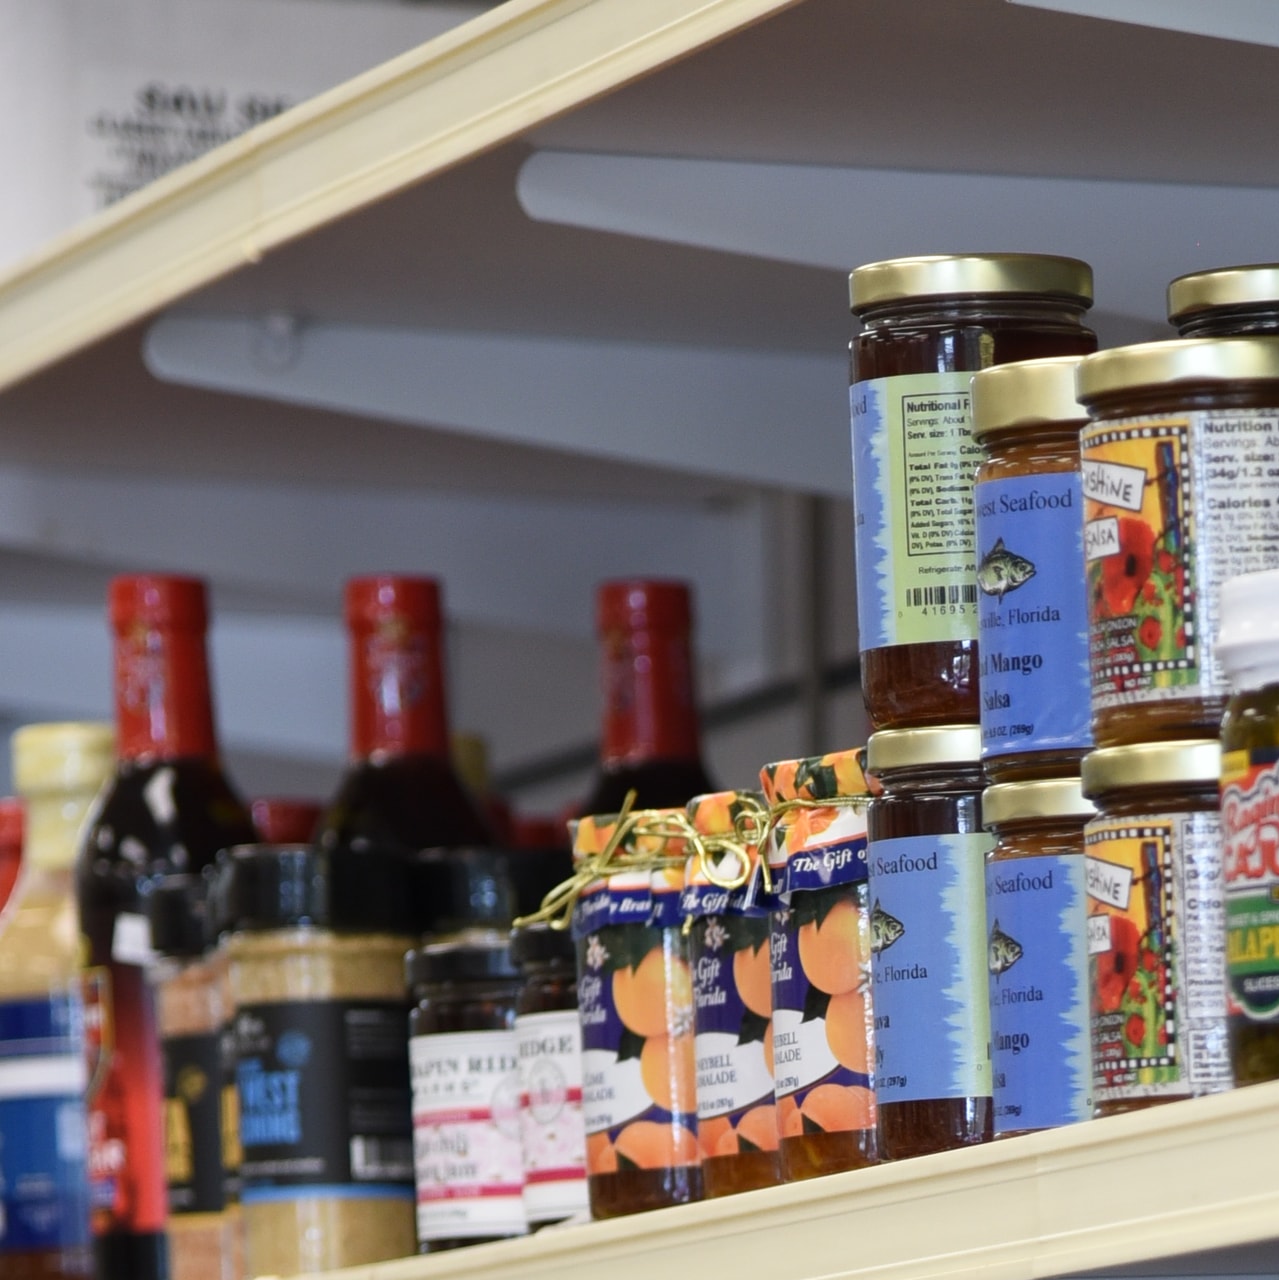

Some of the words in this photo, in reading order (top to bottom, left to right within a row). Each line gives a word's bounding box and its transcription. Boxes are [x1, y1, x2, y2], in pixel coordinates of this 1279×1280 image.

[907, 401, 961, 414] Nutritional
[1203, 421, 1272, 434] Nutrition
[999, 489, 1073, 513] Seafood
[1207, 498, 1271, 510] Calories
[1007, 605, 1061, 625] Florida
[991, 651, 1044, 675] Mango
[793, 857, 819, 872] The
[823, 849, 851, 875] Gift
[876, 852, 938, 876] Seafood
[995, 871, 1053, 895] Seafood
[699, 957, 720, 988] Gift
[884, 964, 927, 982] Florida
[1001, 986, 1043, 1004] Florida
